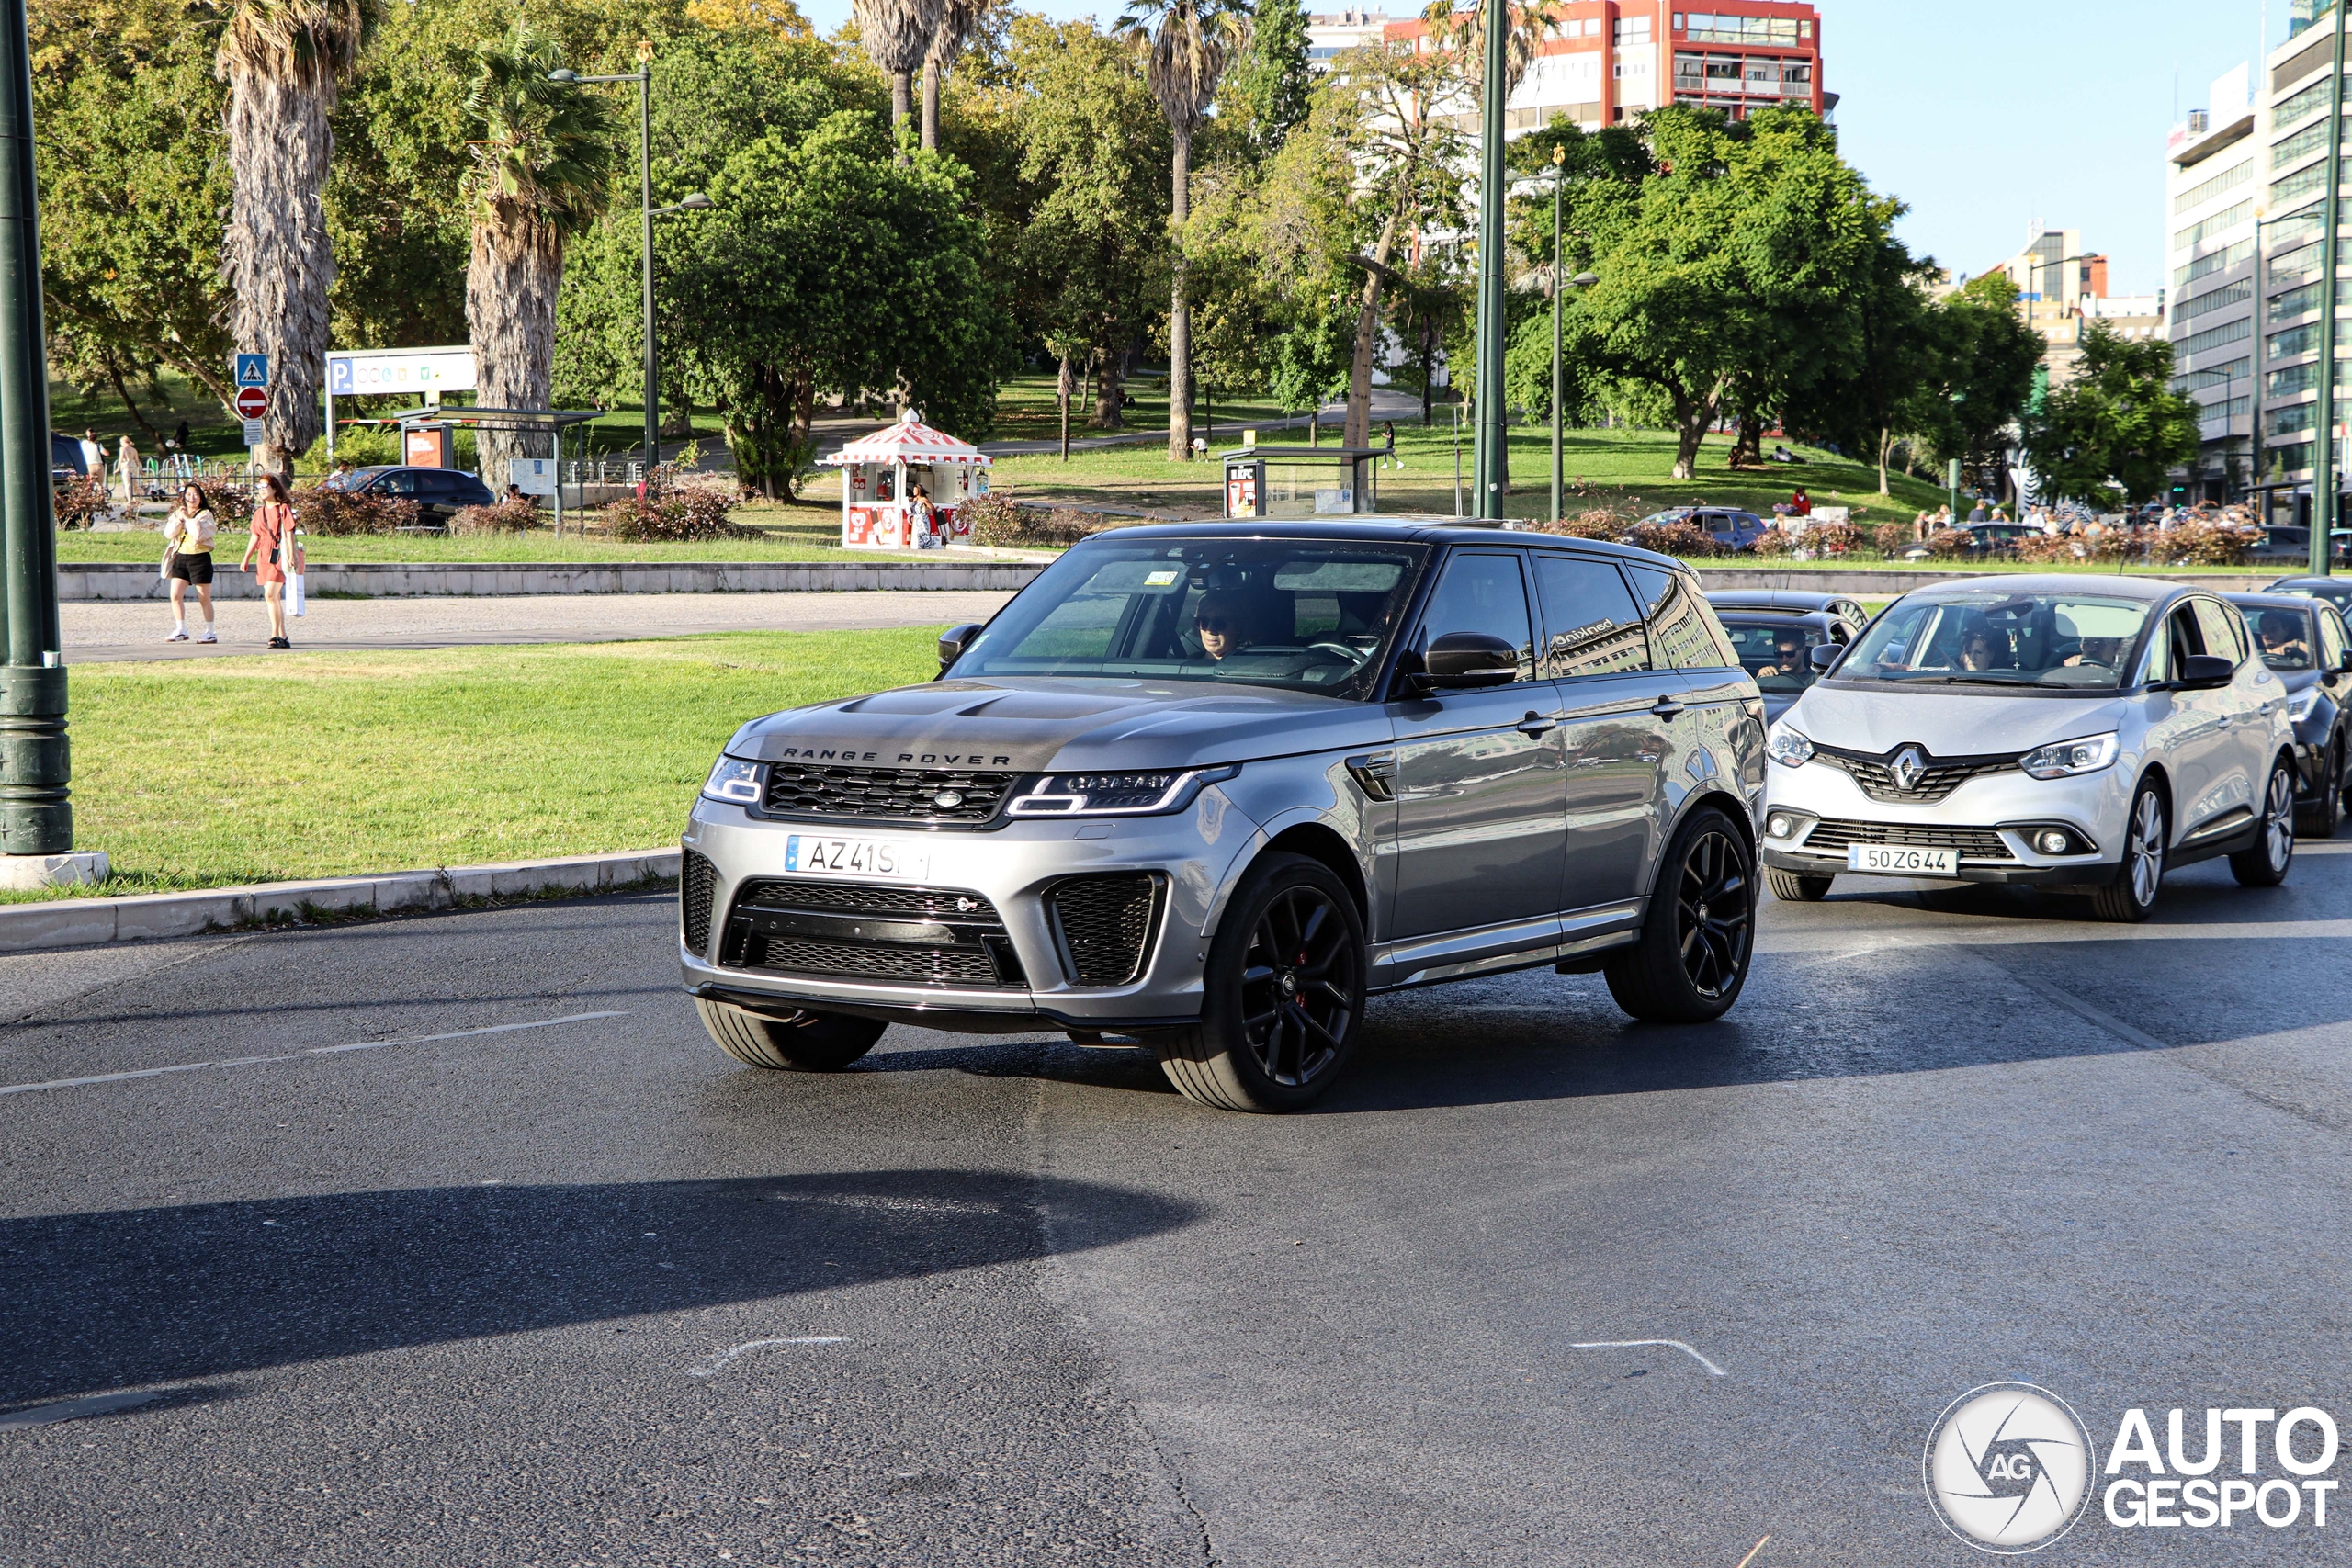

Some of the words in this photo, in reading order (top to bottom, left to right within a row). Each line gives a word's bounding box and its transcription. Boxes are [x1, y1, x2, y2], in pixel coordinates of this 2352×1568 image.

[334, 363, 348, 389] P
[1237, 468, 1254, 480] KFC
[783, 747, 877, 762] RANGE
[897, 753, 1012, 766] ROVER
[808, 840, 900, 874] AZ41S
[1868, 850, 1946, 870] 50ZG44
